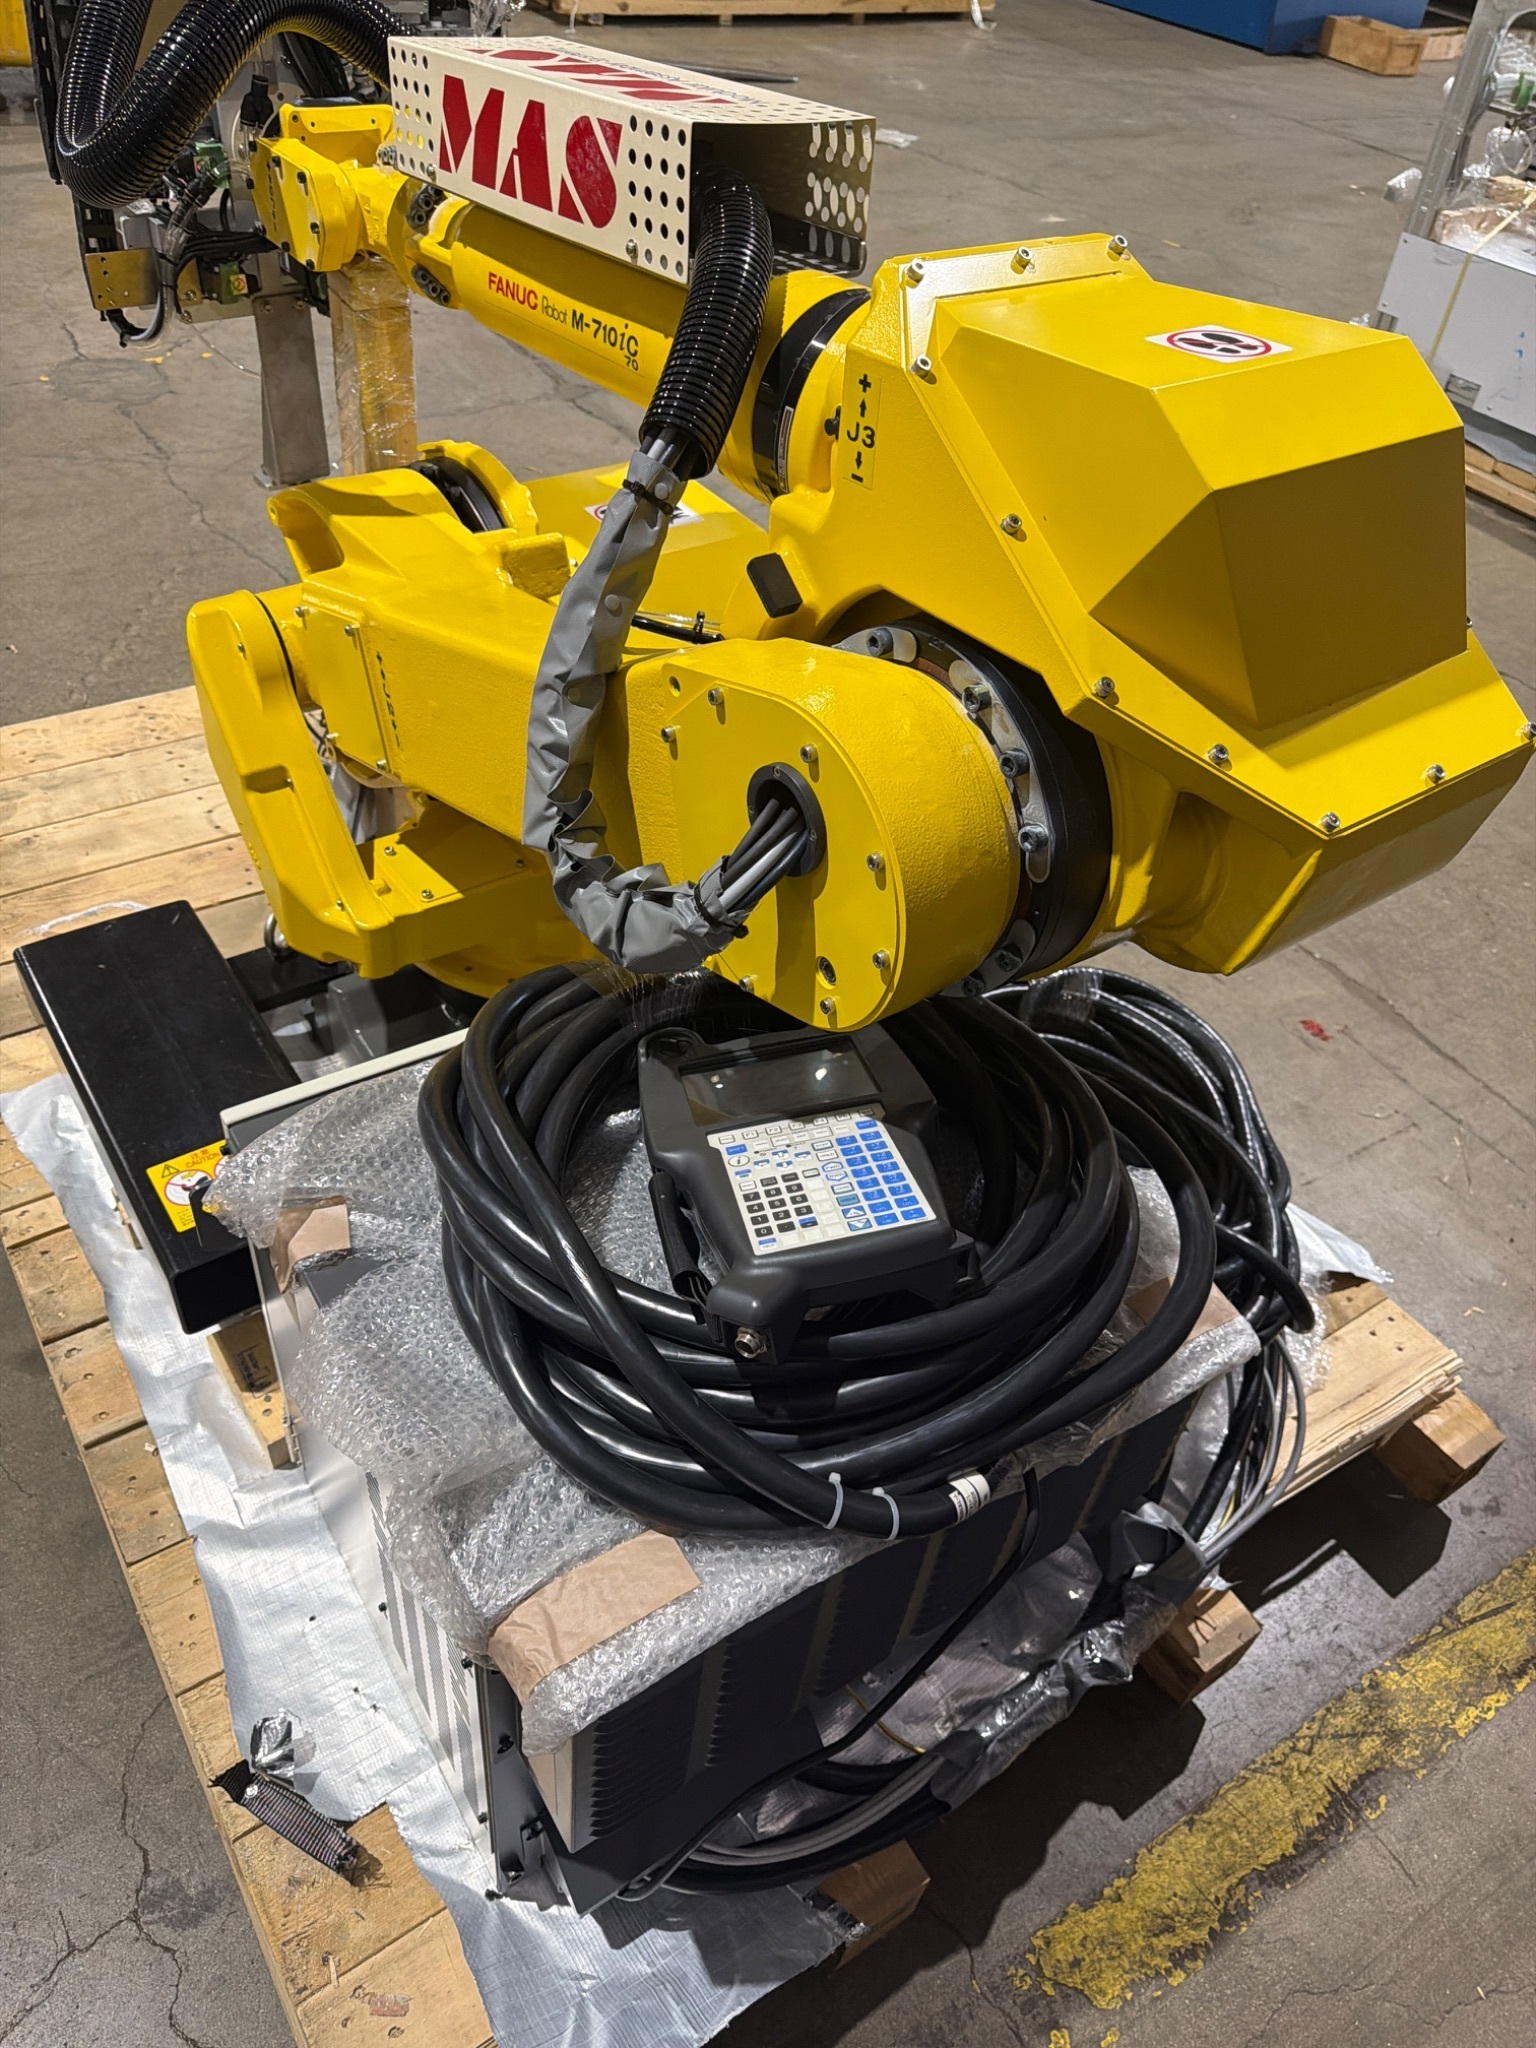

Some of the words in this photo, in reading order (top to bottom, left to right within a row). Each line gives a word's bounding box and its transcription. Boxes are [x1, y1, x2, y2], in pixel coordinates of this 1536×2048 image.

[439, 74, 623, 229] MAS
[488, 271, 539, 311] FANUC
[541, 295, 569, 325] Robot
[624, 355, 639, 371] 70
[846, 422, 876, 449] J3
